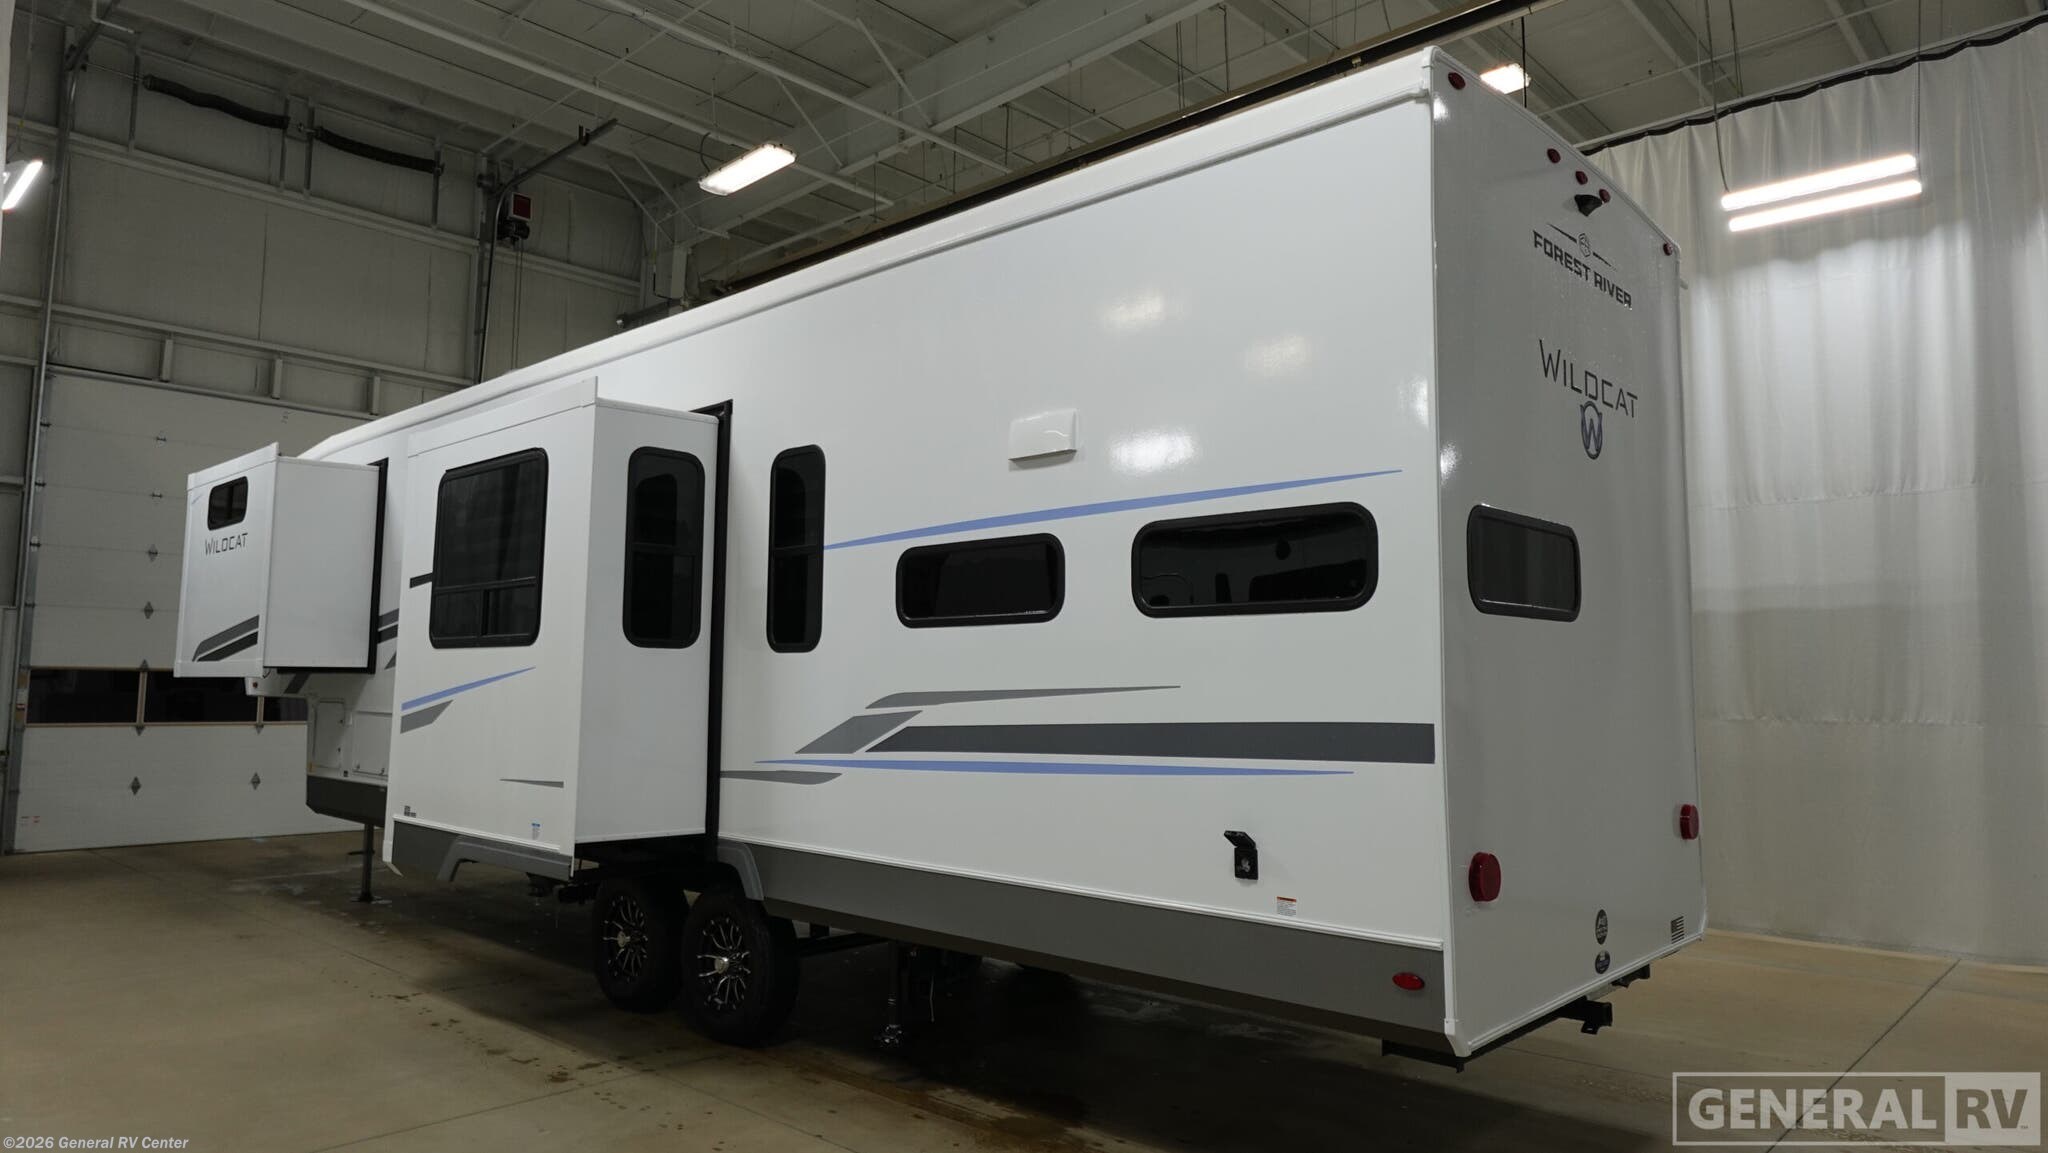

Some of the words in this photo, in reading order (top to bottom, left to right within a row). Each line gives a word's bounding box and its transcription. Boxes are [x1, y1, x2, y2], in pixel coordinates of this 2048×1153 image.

[1533, 230, 1590, 281] FOREST
[1594, 271, 1632, 309] RIVER
[1539, 339, 1638, 418] WILDCAT
[205, 532, 249, 556] WILDCAT
